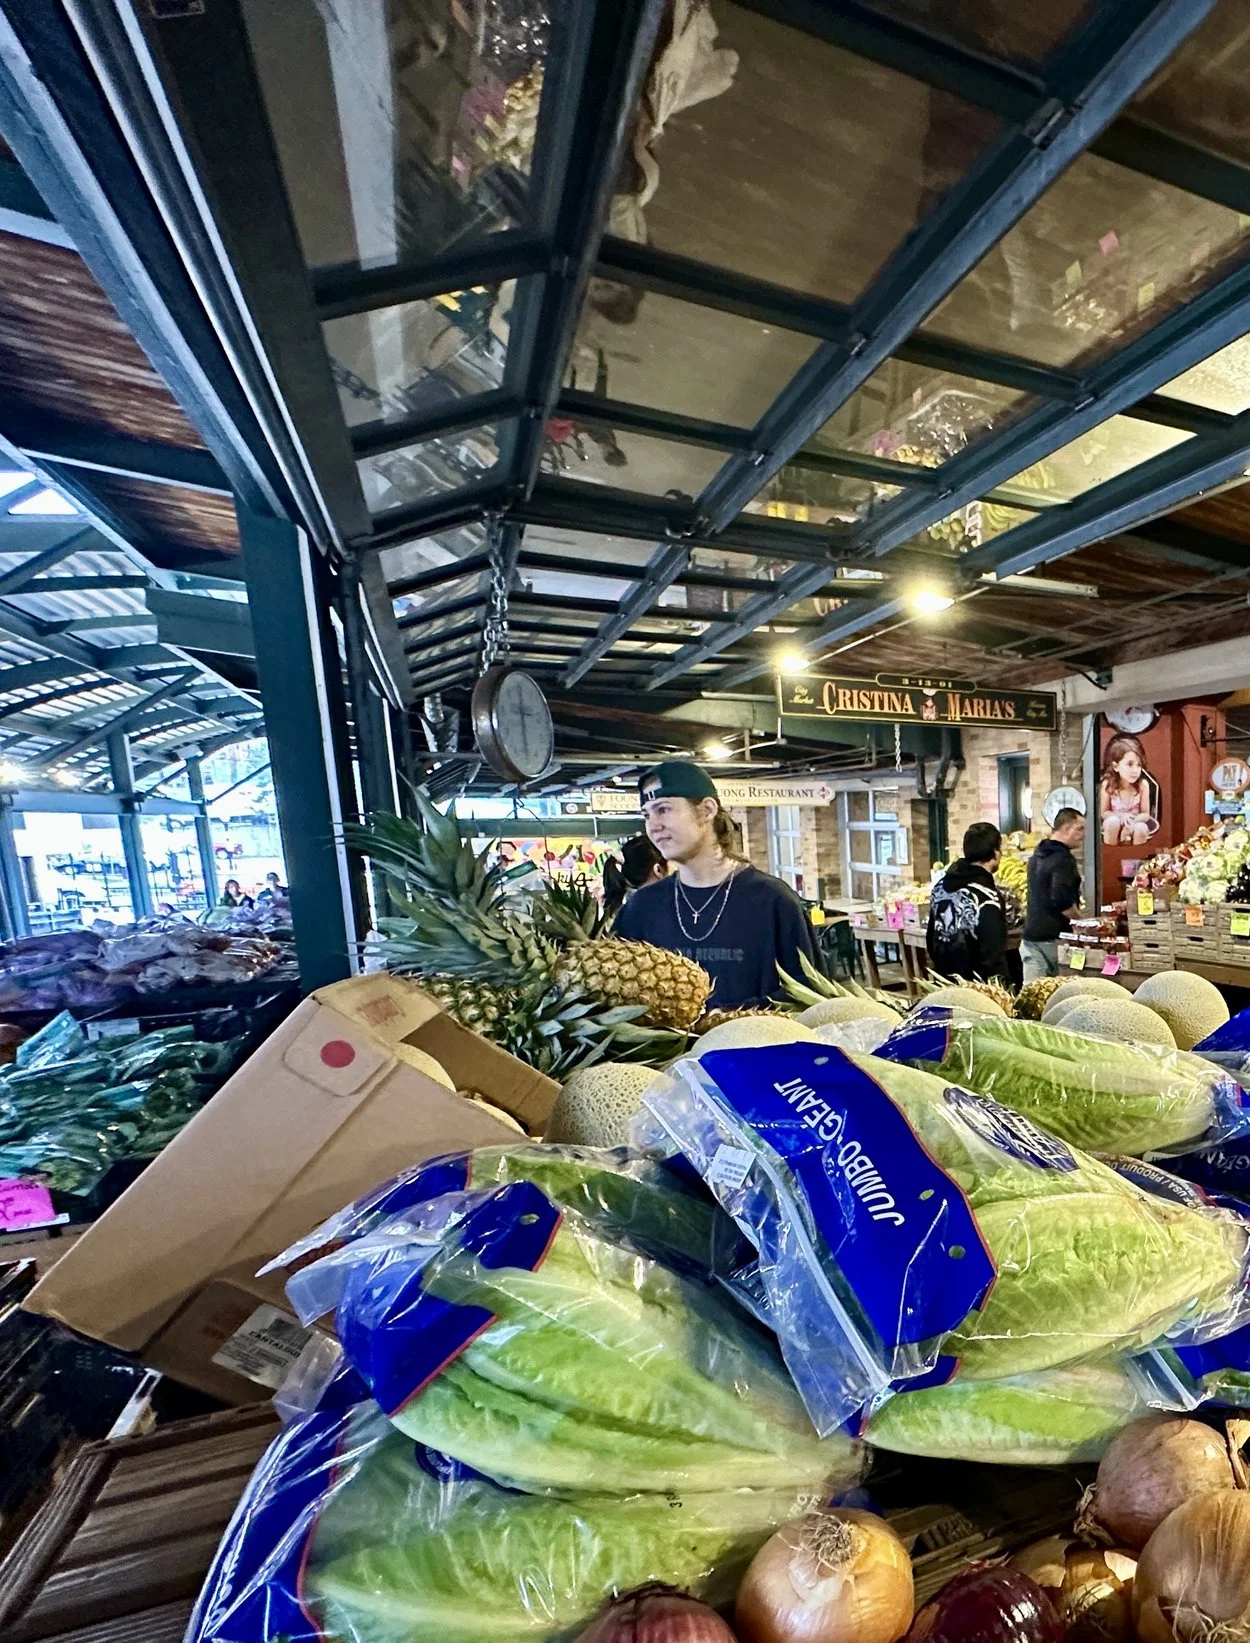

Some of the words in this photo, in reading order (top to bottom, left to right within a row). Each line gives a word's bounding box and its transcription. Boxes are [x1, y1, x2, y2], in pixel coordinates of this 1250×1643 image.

[822, 681, 914, 714] CRISTINA
[947, 692, 1015, 721] MARIA'S
[748, 786, 815, 798] RESTAURANT
[838, 1140, 905, 1226] JUMBO
[1119, 1161, 1165, 1184] PRODUIT
[1168, 1180, 1188, 1199] USA
